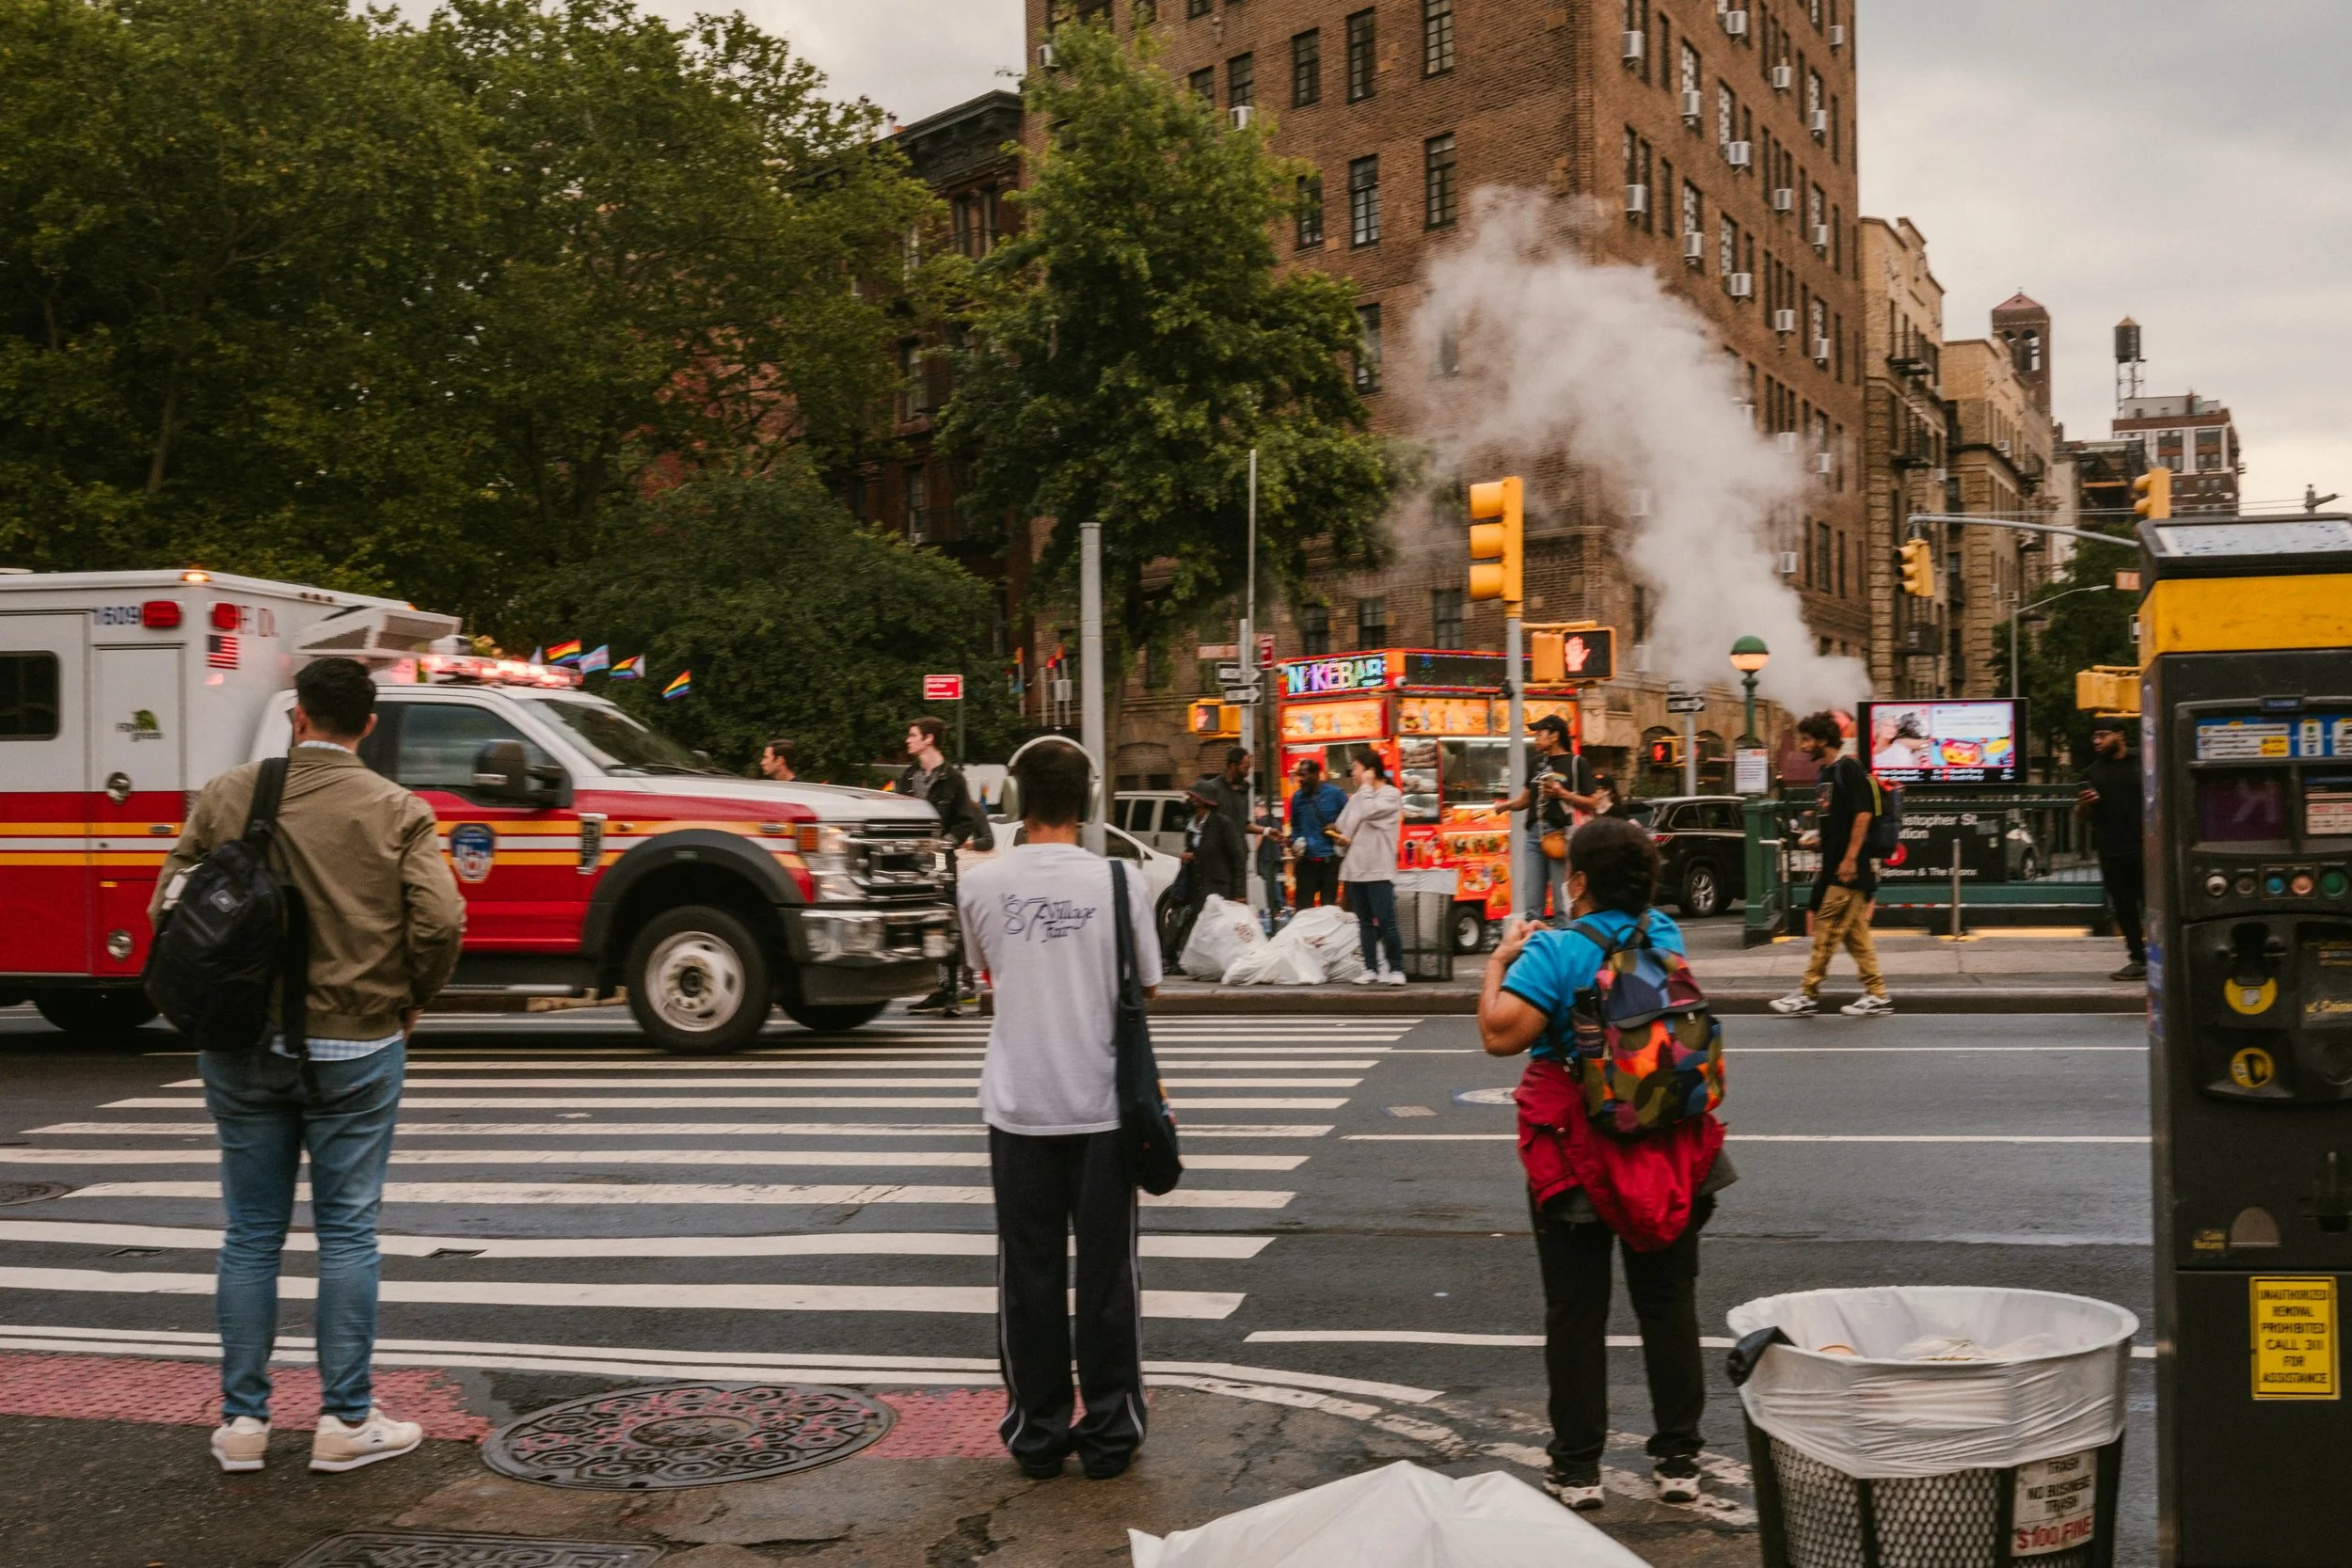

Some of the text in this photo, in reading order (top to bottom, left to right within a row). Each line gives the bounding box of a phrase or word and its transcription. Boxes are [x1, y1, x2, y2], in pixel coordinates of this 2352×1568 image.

[94, 606, 140, 626] 1609
[1900, 815, 1958, 828] istopher
[1880, 867, 1978, 878] Uptown & The Bonx
[2261, 1290, 2327, 1300] UNAUTHORIZED
[2272, 1306, 2314, 1317] REMOVAL
[2261, 1323, 2326, 1334] PROHIBITED
[2265, 1338, 2299, 1351] CALL
[2283, 1355, 2305, 1367] FOR
[2263, 1372, 2328, 1384] ASSISTANCE
[2026, 1475, 2092, 1500] NO BUSINESS
[2045, 1495, 2079, 1513] TRASH
[2016, 1515, 2093, 1549] $100 FINE
